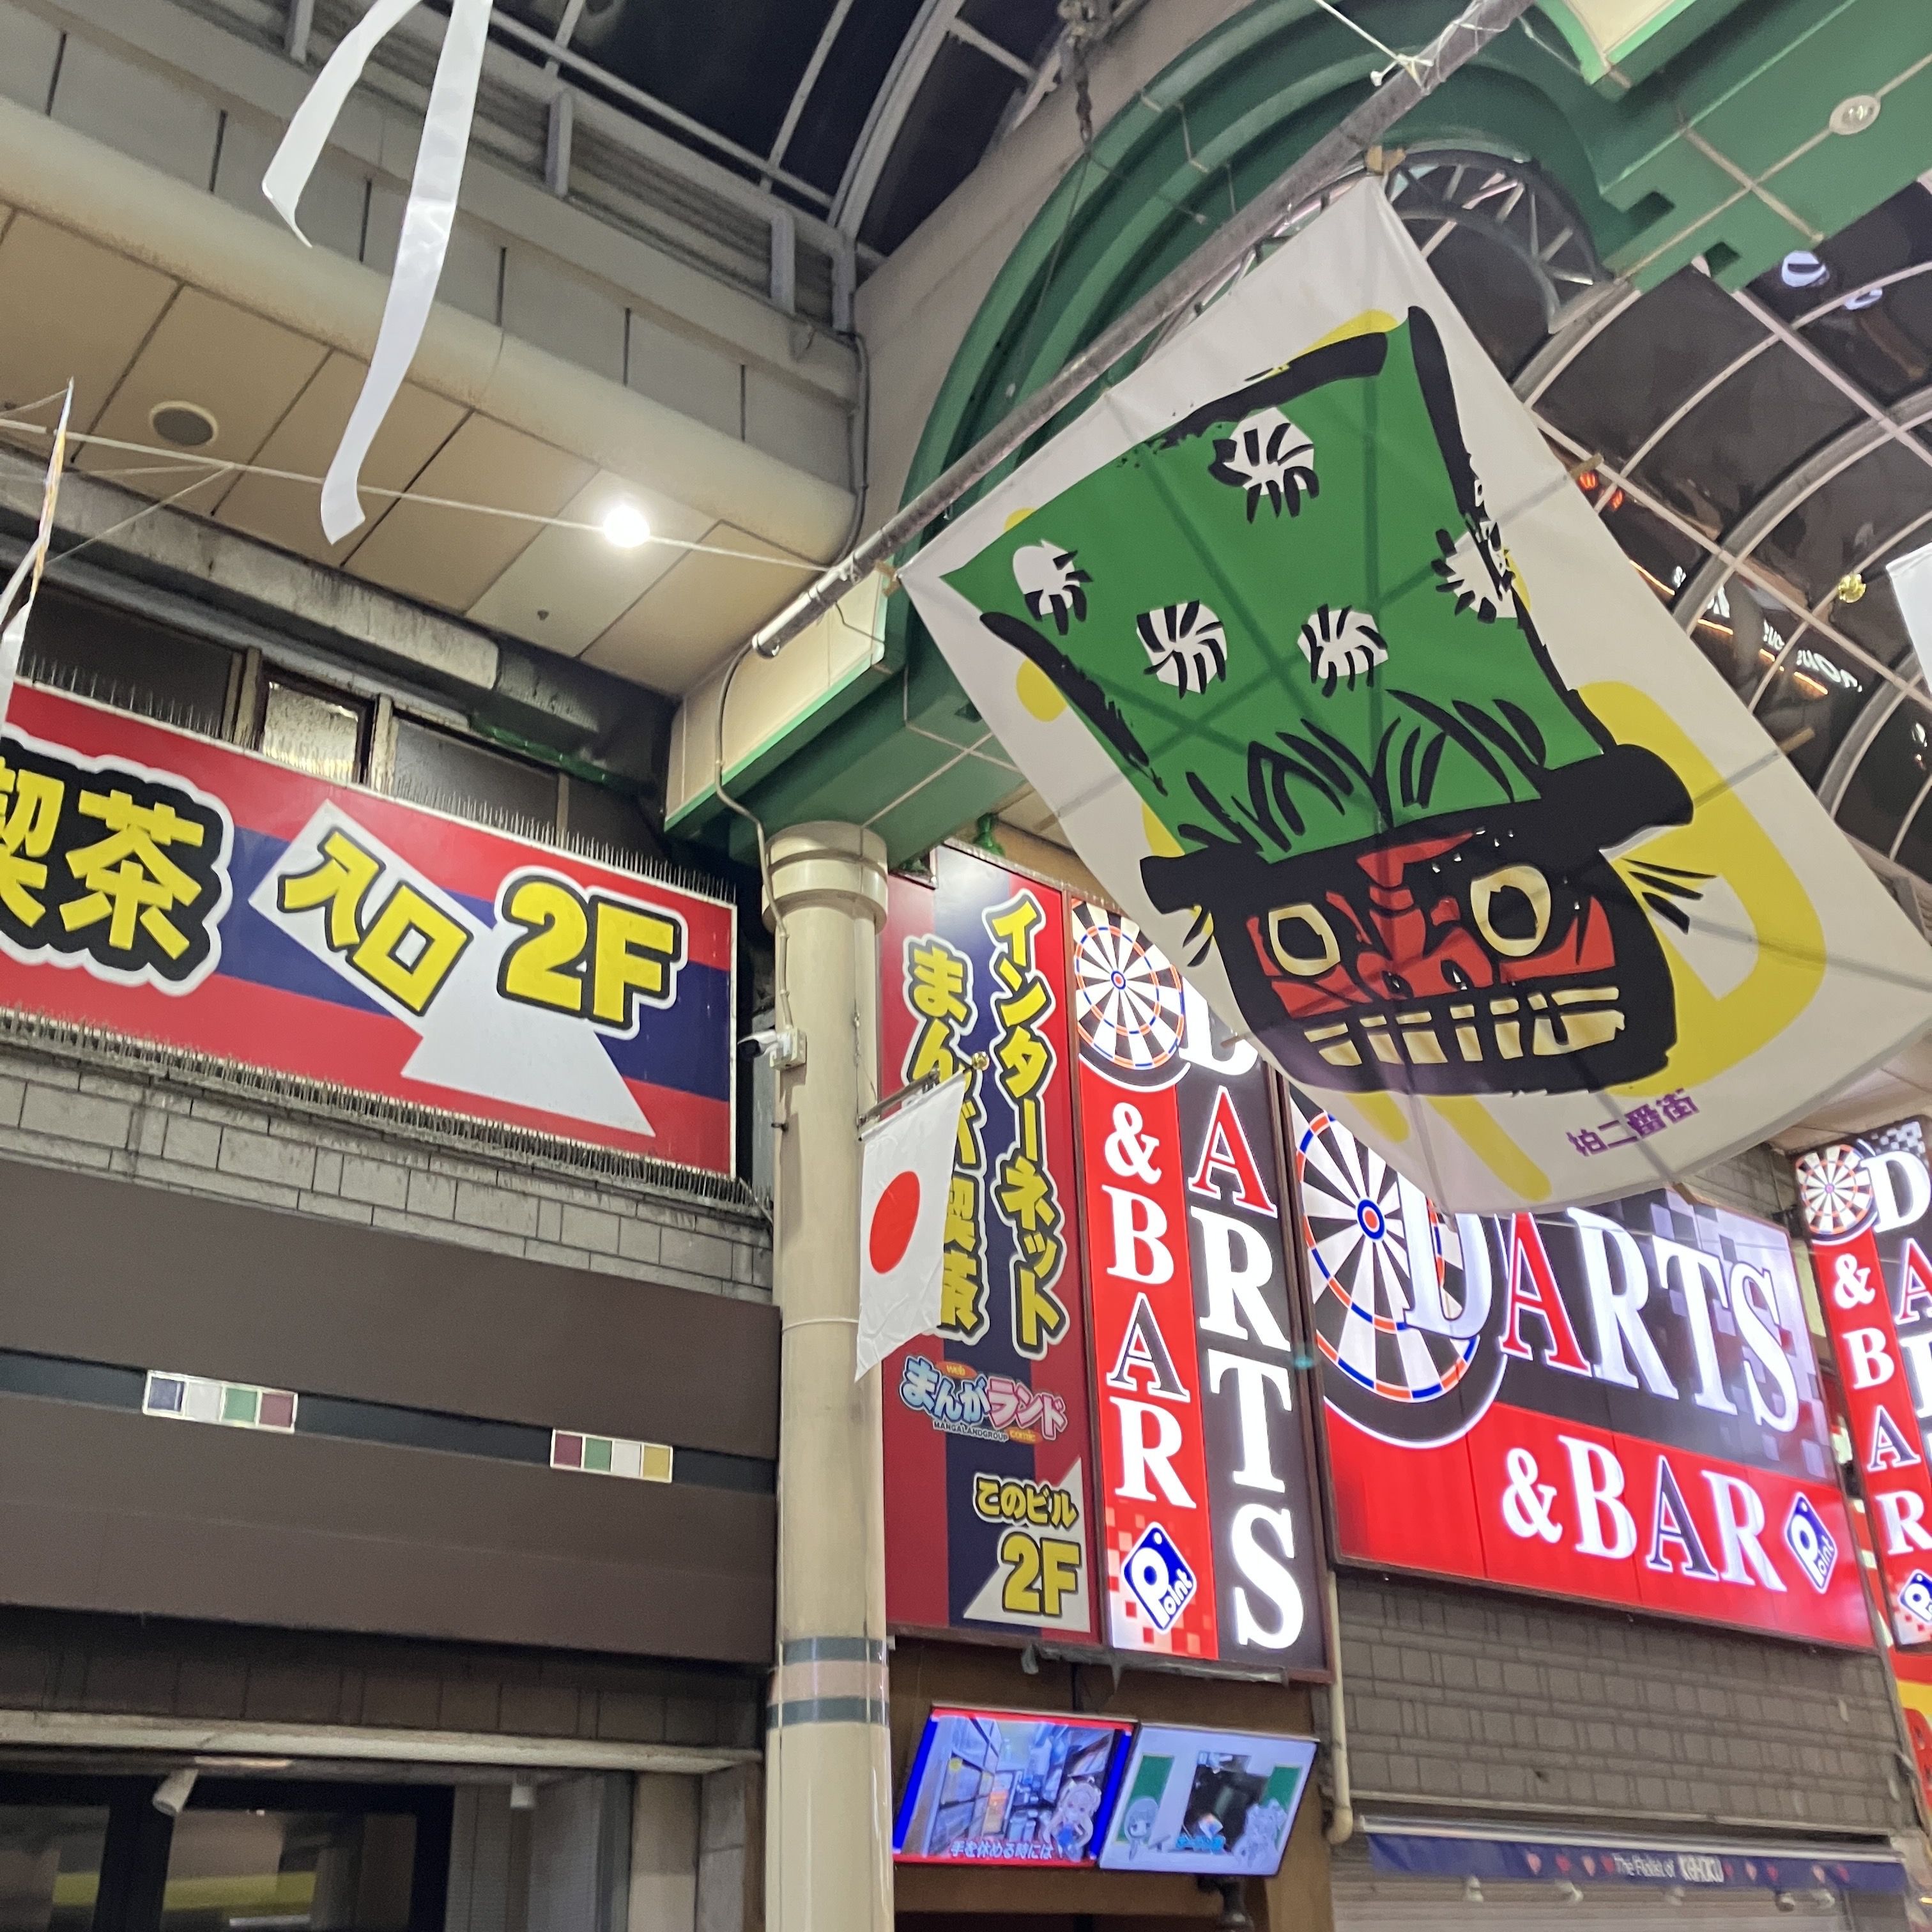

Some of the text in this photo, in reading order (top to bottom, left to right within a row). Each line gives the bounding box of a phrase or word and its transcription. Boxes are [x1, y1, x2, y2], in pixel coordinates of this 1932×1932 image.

[281, 828, 471, 1015] 入口
[503, 879, 677, 1023] 2F
[992, 899, 1061, 1346] インターネット
[1565, 1087, 1700, 1157] 柏二番街
[1396, 1172, 1798, 1432] DARTS
[900, 1356, 1068, 1439] まんがランド
[933, 1420, 1009, 1442] MANGALANDGROUP
[977, 1480, 1078, 1526] このビル
[1002, 1533, 1082, 1616] 2F
[1131, 1547, 1193, 1629] Point
[1791, 1514, 1834, 1587] Point
